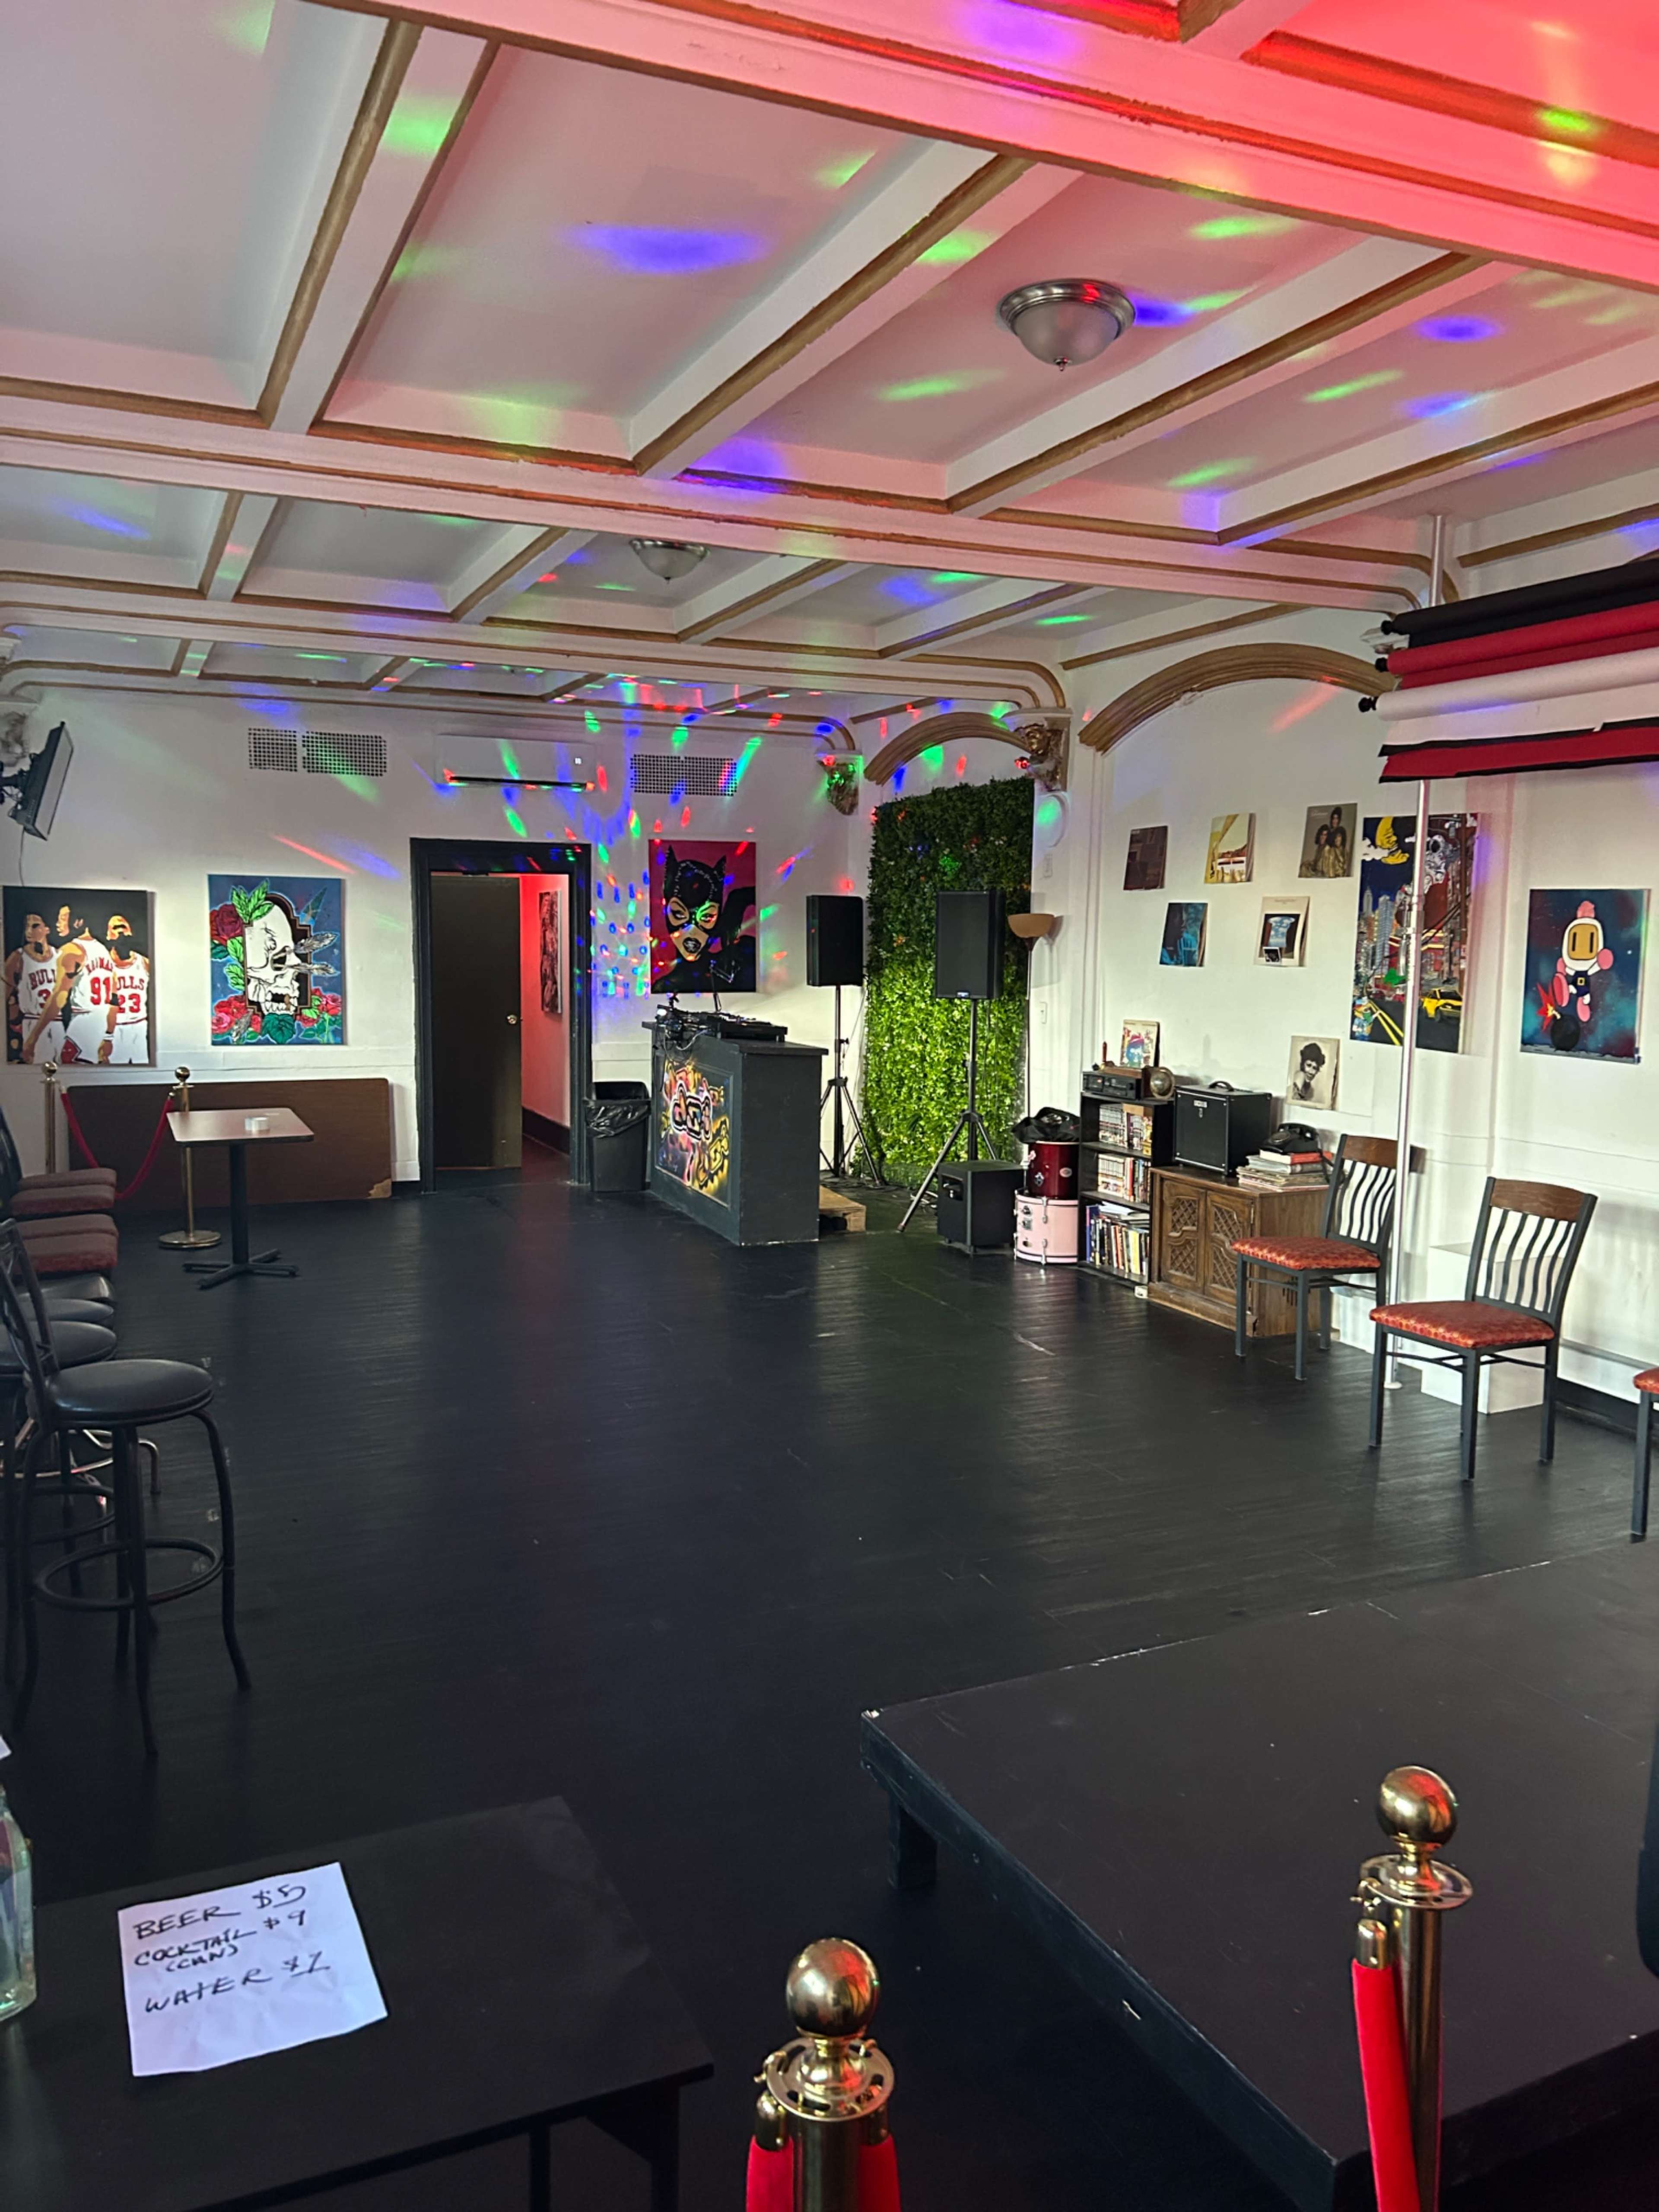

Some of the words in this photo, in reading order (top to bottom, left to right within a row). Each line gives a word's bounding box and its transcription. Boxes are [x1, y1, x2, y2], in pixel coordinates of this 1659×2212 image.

[90, 976, 111, 1006] 91
[117, 993, 141, 1013] 23
[133, 1906, 242, 1940] BEER
[251, 1884, 306, 1909] $5
[133, 1928, 257, 1966] COCKTAIL
[145, 1968, 273, 2012] WATER
